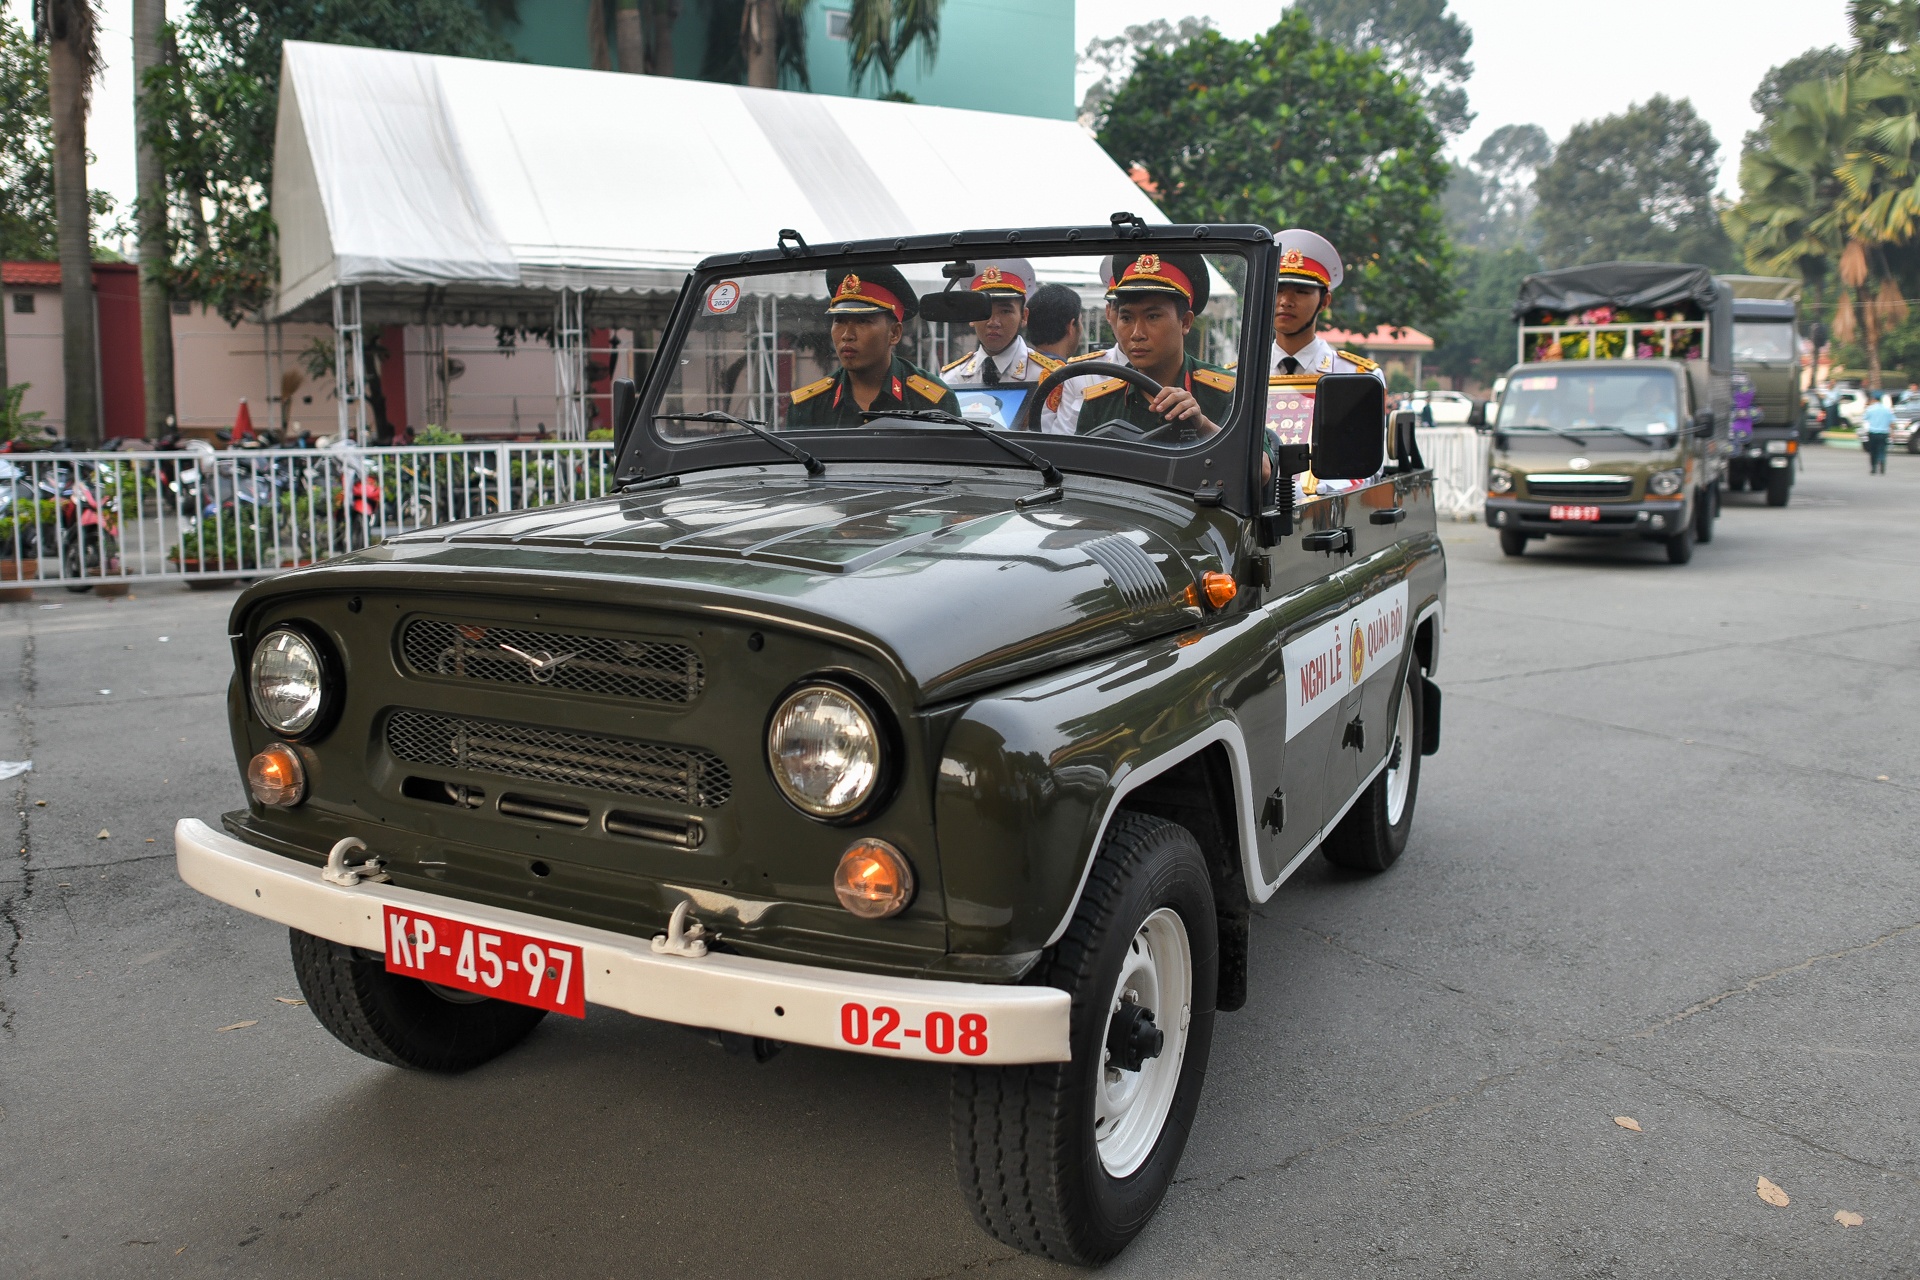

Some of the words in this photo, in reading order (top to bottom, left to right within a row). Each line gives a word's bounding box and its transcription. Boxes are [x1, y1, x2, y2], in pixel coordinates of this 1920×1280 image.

[721, 288, 728, 296] 2
[1300, 652, 1327, 707] NGHI
[1329, 624, 1342, 686] LỄ
[1367, 608, 1389, 661] QUÂN
[1390, 598, 1403, 644] ĐỘI
[389, 913, 573, 1006] KP-45-97
[840, 1003, 988, 1056] 02-08
